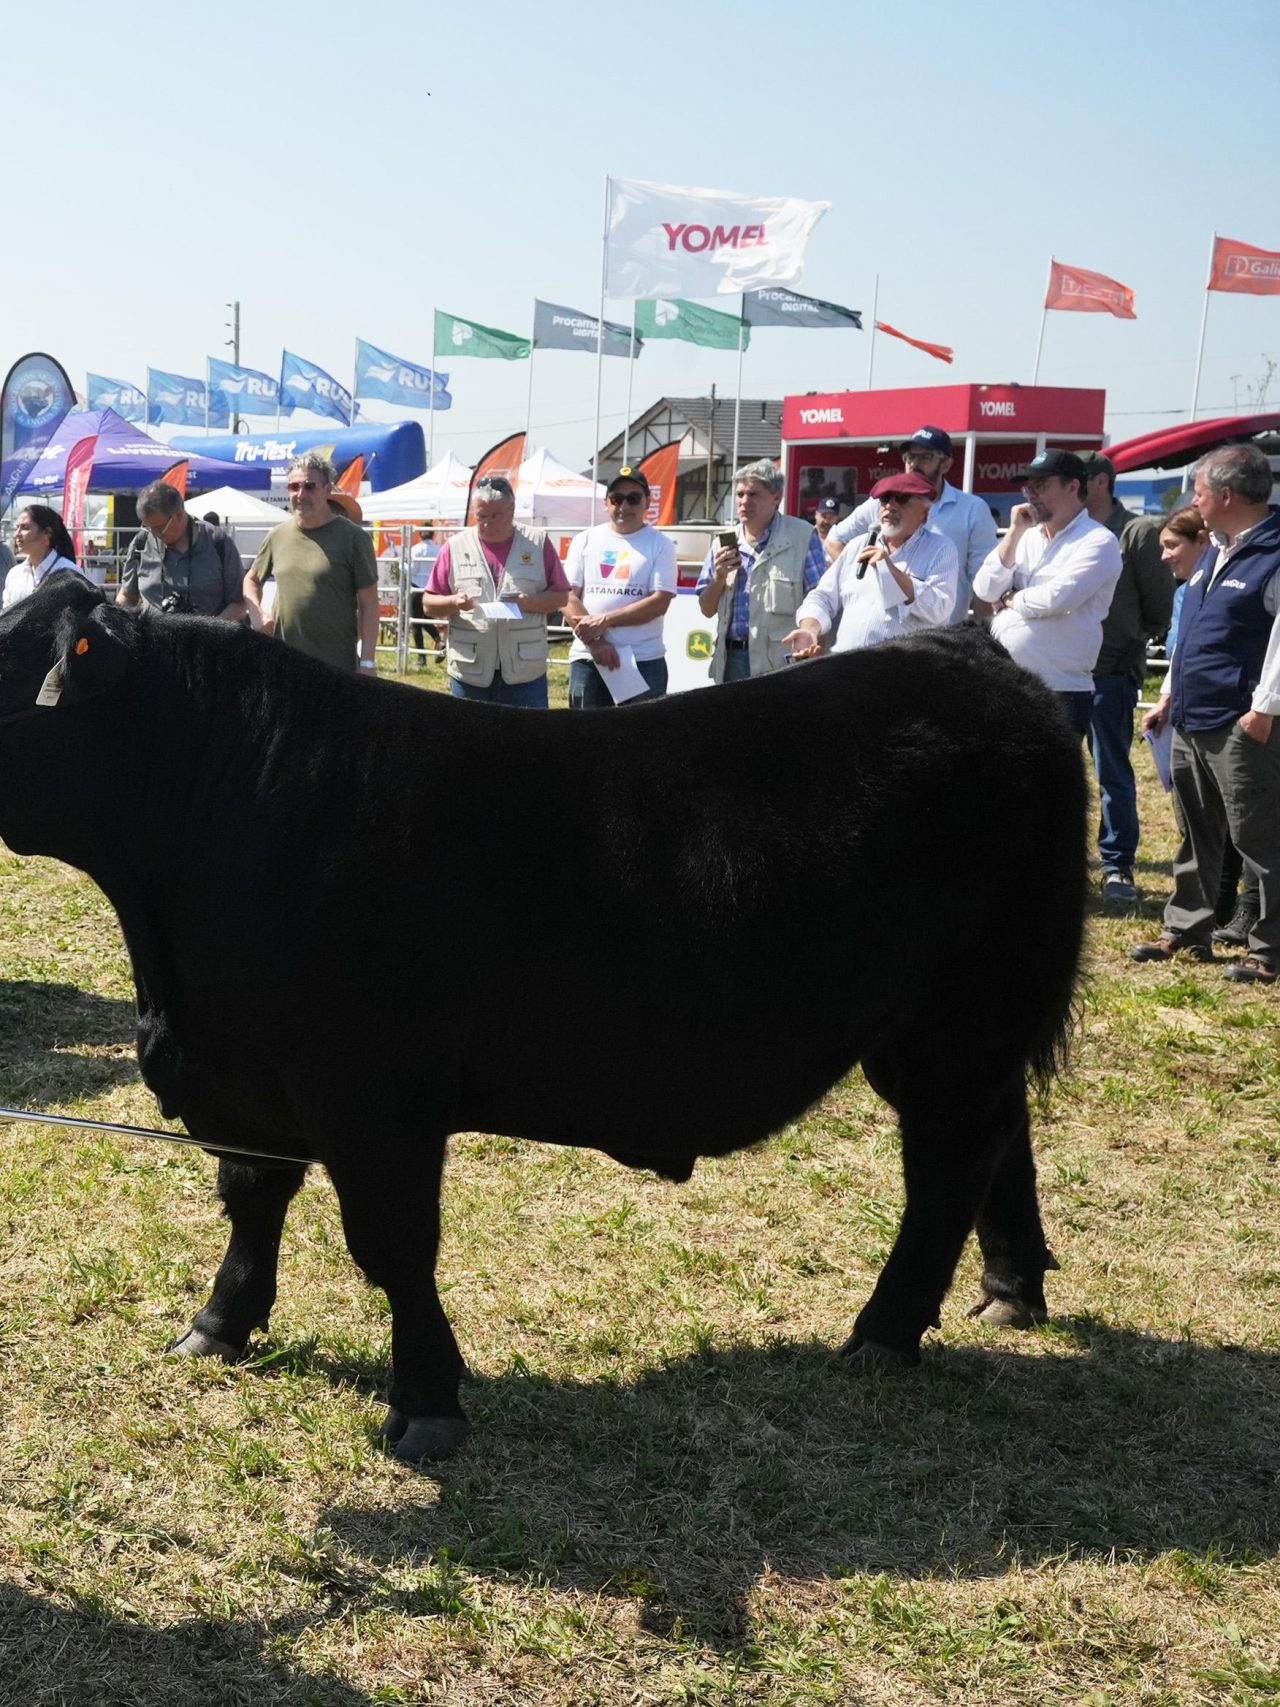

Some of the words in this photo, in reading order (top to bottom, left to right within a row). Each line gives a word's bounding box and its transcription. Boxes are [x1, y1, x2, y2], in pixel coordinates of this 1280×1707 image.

[662, 223, 769, 253] YOMEL
[247, 377, 279, 397] RU
[120, 389, 146, 405] RU
[186, 391, 210, 408] RU
[800, 409, 844, 423] YOMEL
[980, 402, 1016, 416] YOMEL
[235, 440, 296, 461] Tru-Test
[978, 463, 1029, 480] YOME
[586, 586, 644, 596] CATAMARCA
